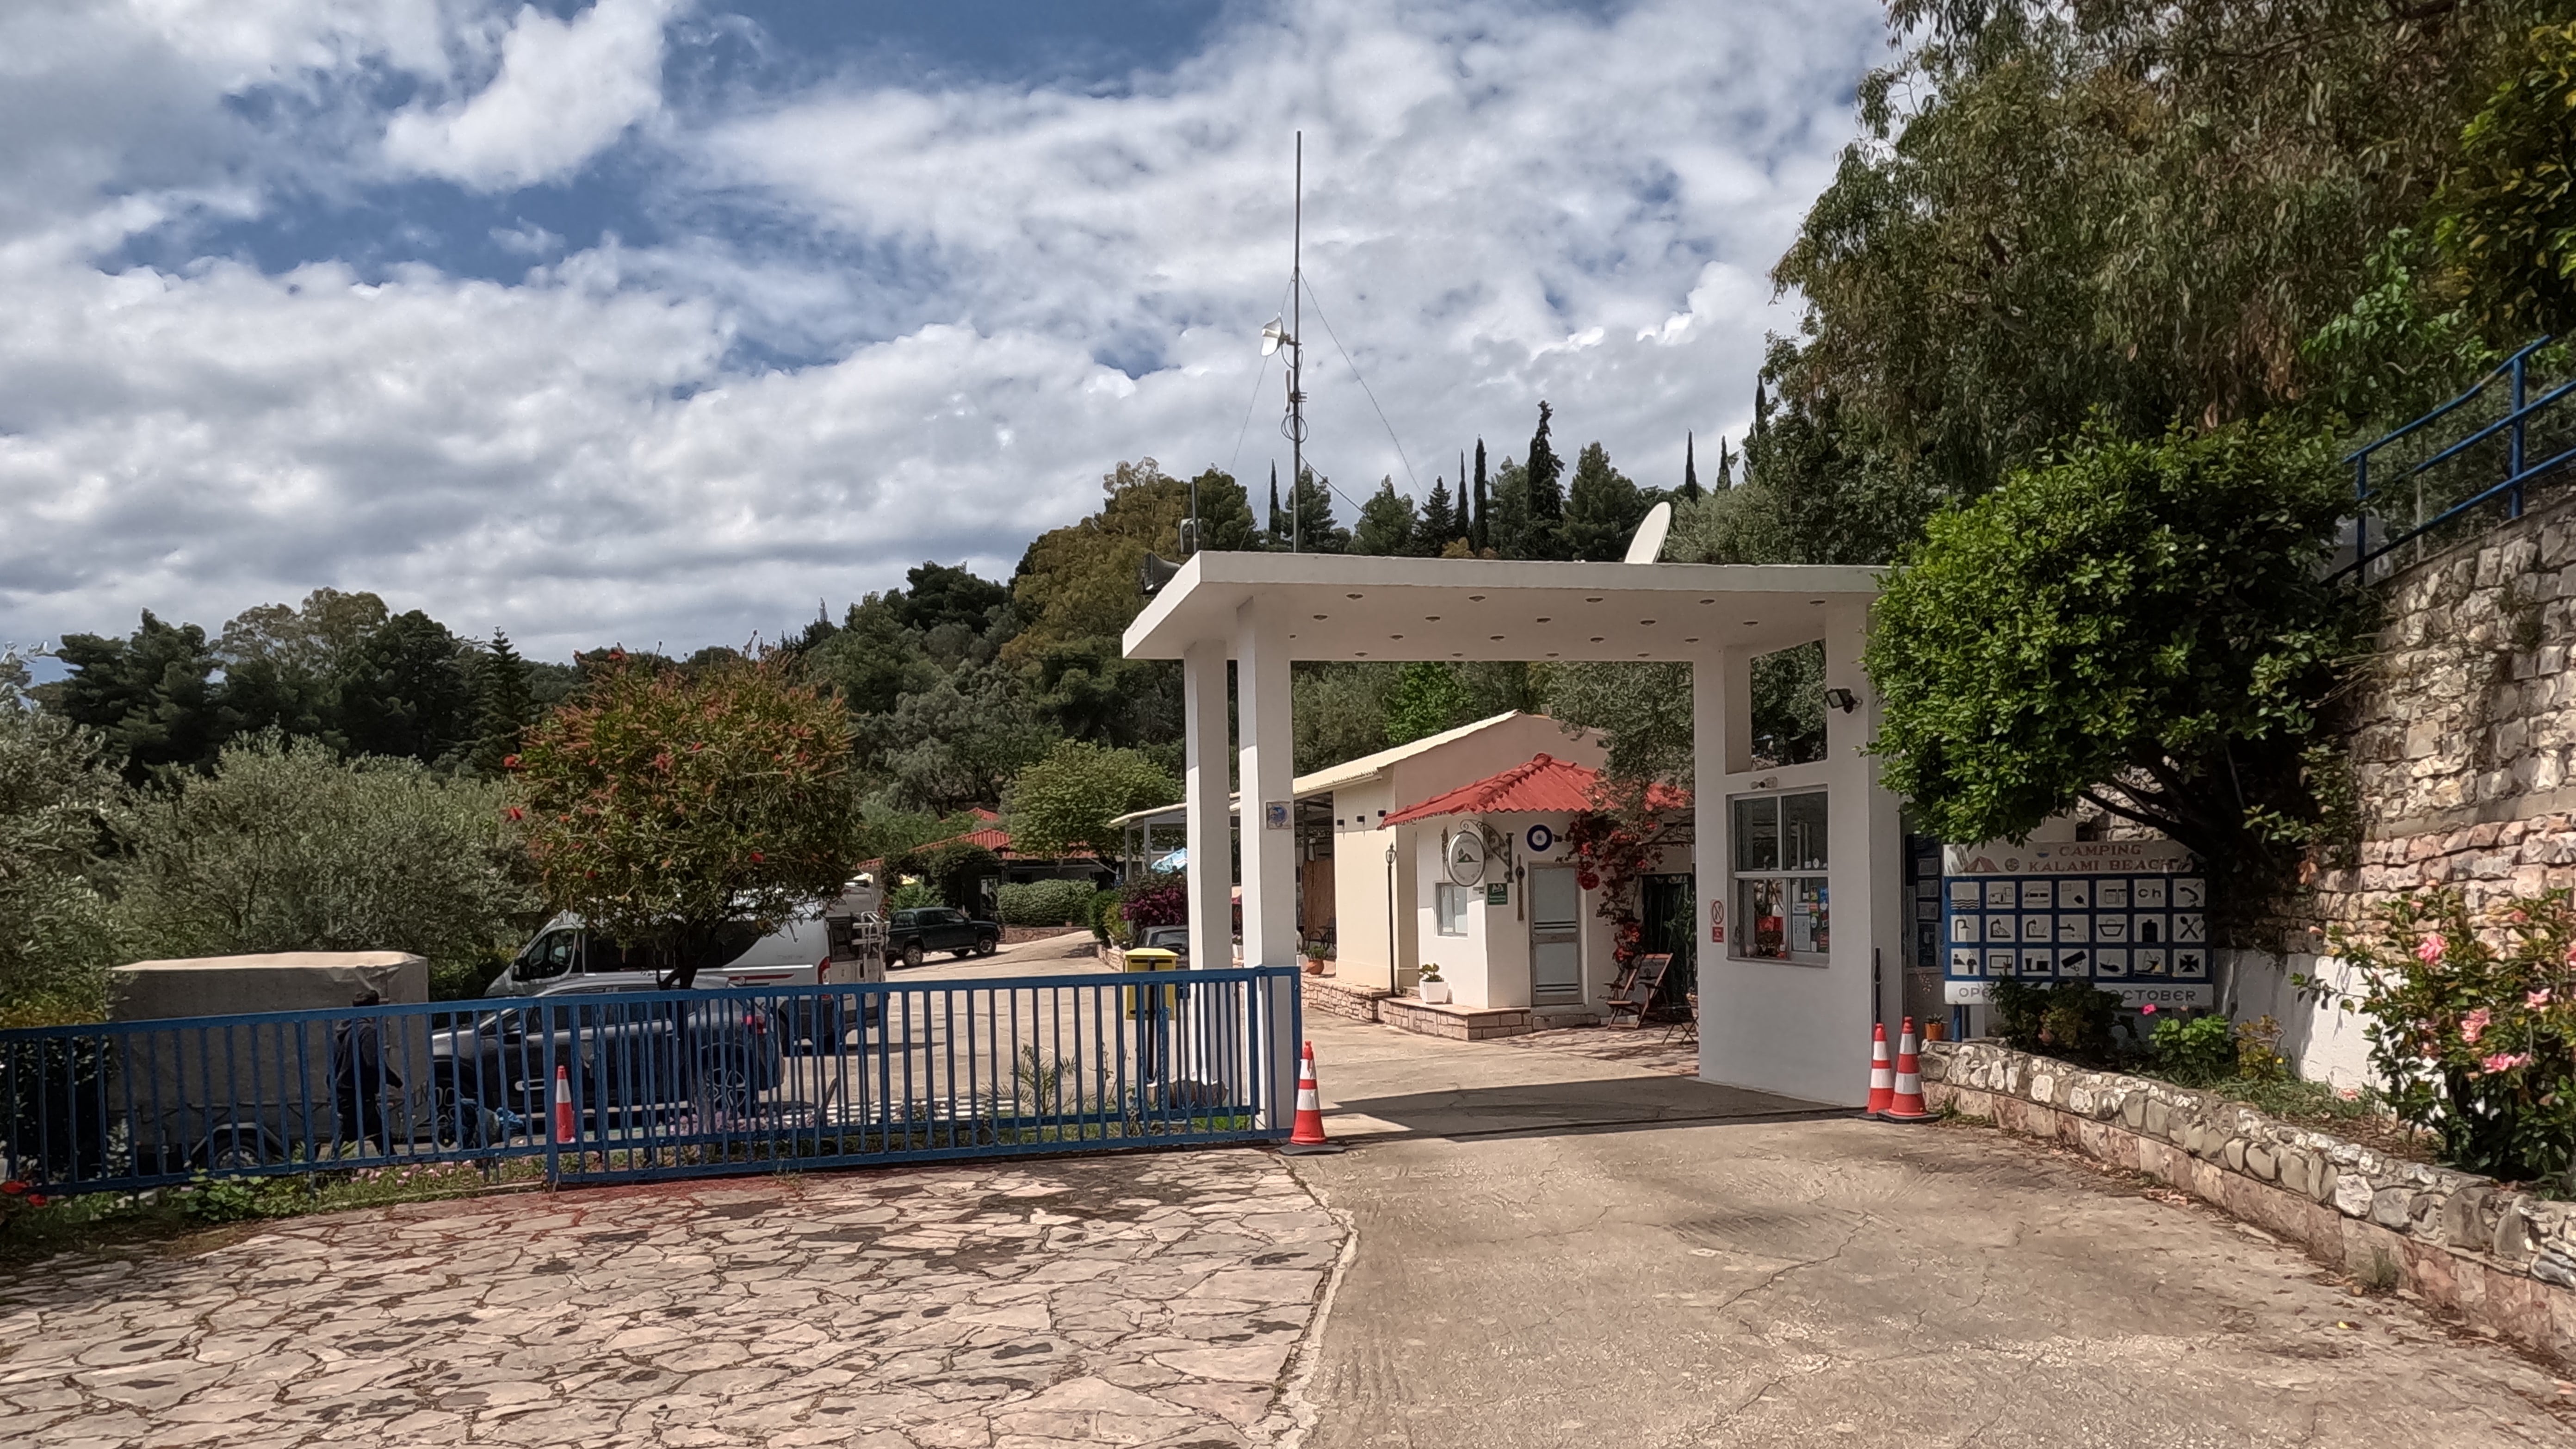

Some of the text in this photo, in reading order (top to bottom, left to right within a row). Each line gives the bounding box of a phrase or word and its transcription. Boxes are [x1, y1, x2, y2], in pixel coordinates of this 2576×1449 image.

[2059, 845, 2142, 856] CAMPING
[2028, 859, 2174, 872] KALAMI BEACH
